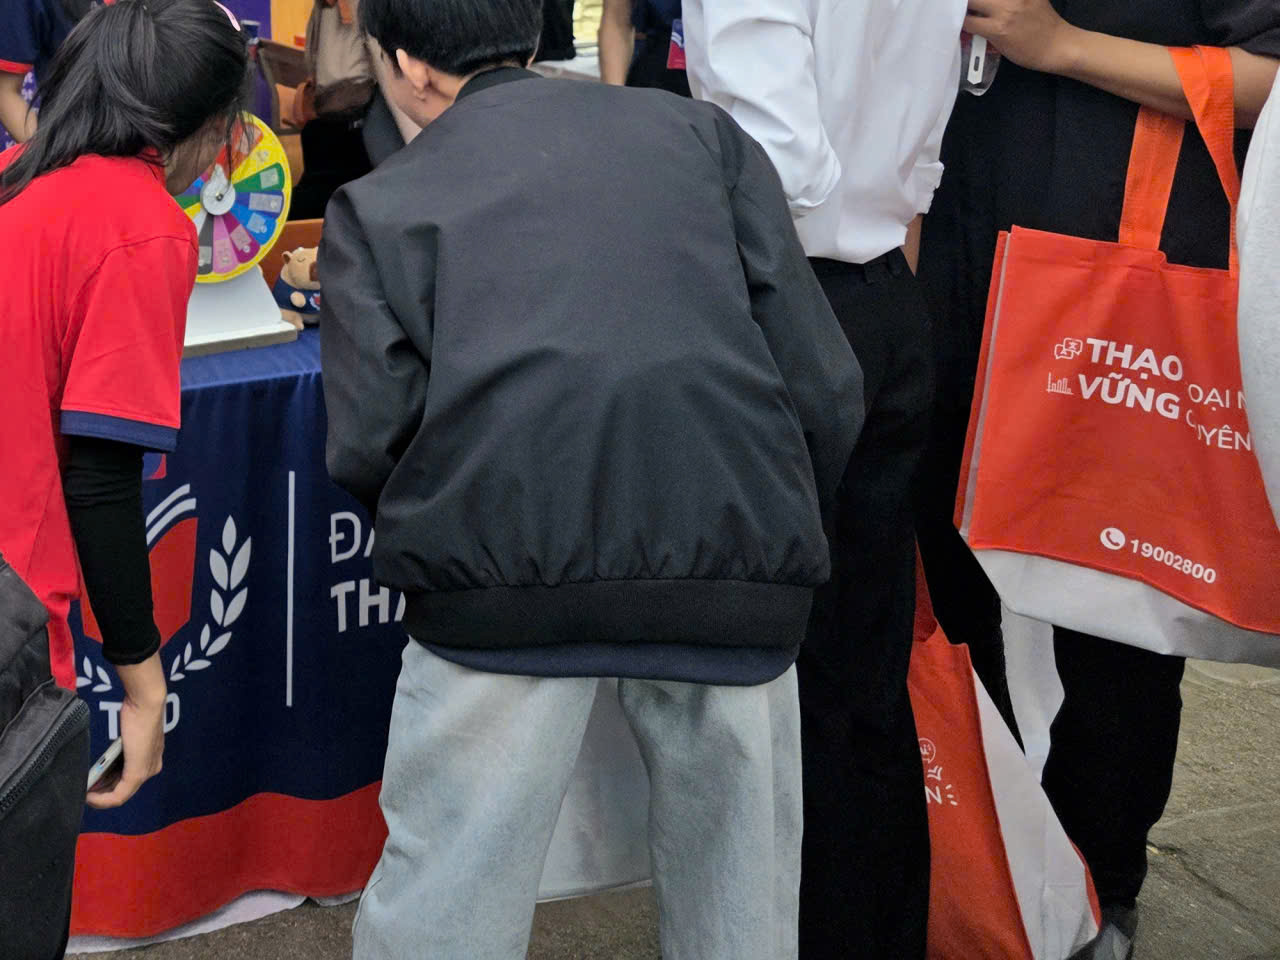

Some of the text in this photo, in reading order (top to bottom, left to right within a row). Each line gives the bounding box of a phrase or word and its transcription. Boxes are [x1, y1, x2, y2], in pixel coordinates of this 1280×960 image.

[1086, 337, 1184, 381] THẠO
[1078, 372, 1180, 420] VỮNG
[1130, 538, 1217, 584] 19002800
[99, 691, 181, 740] TD
